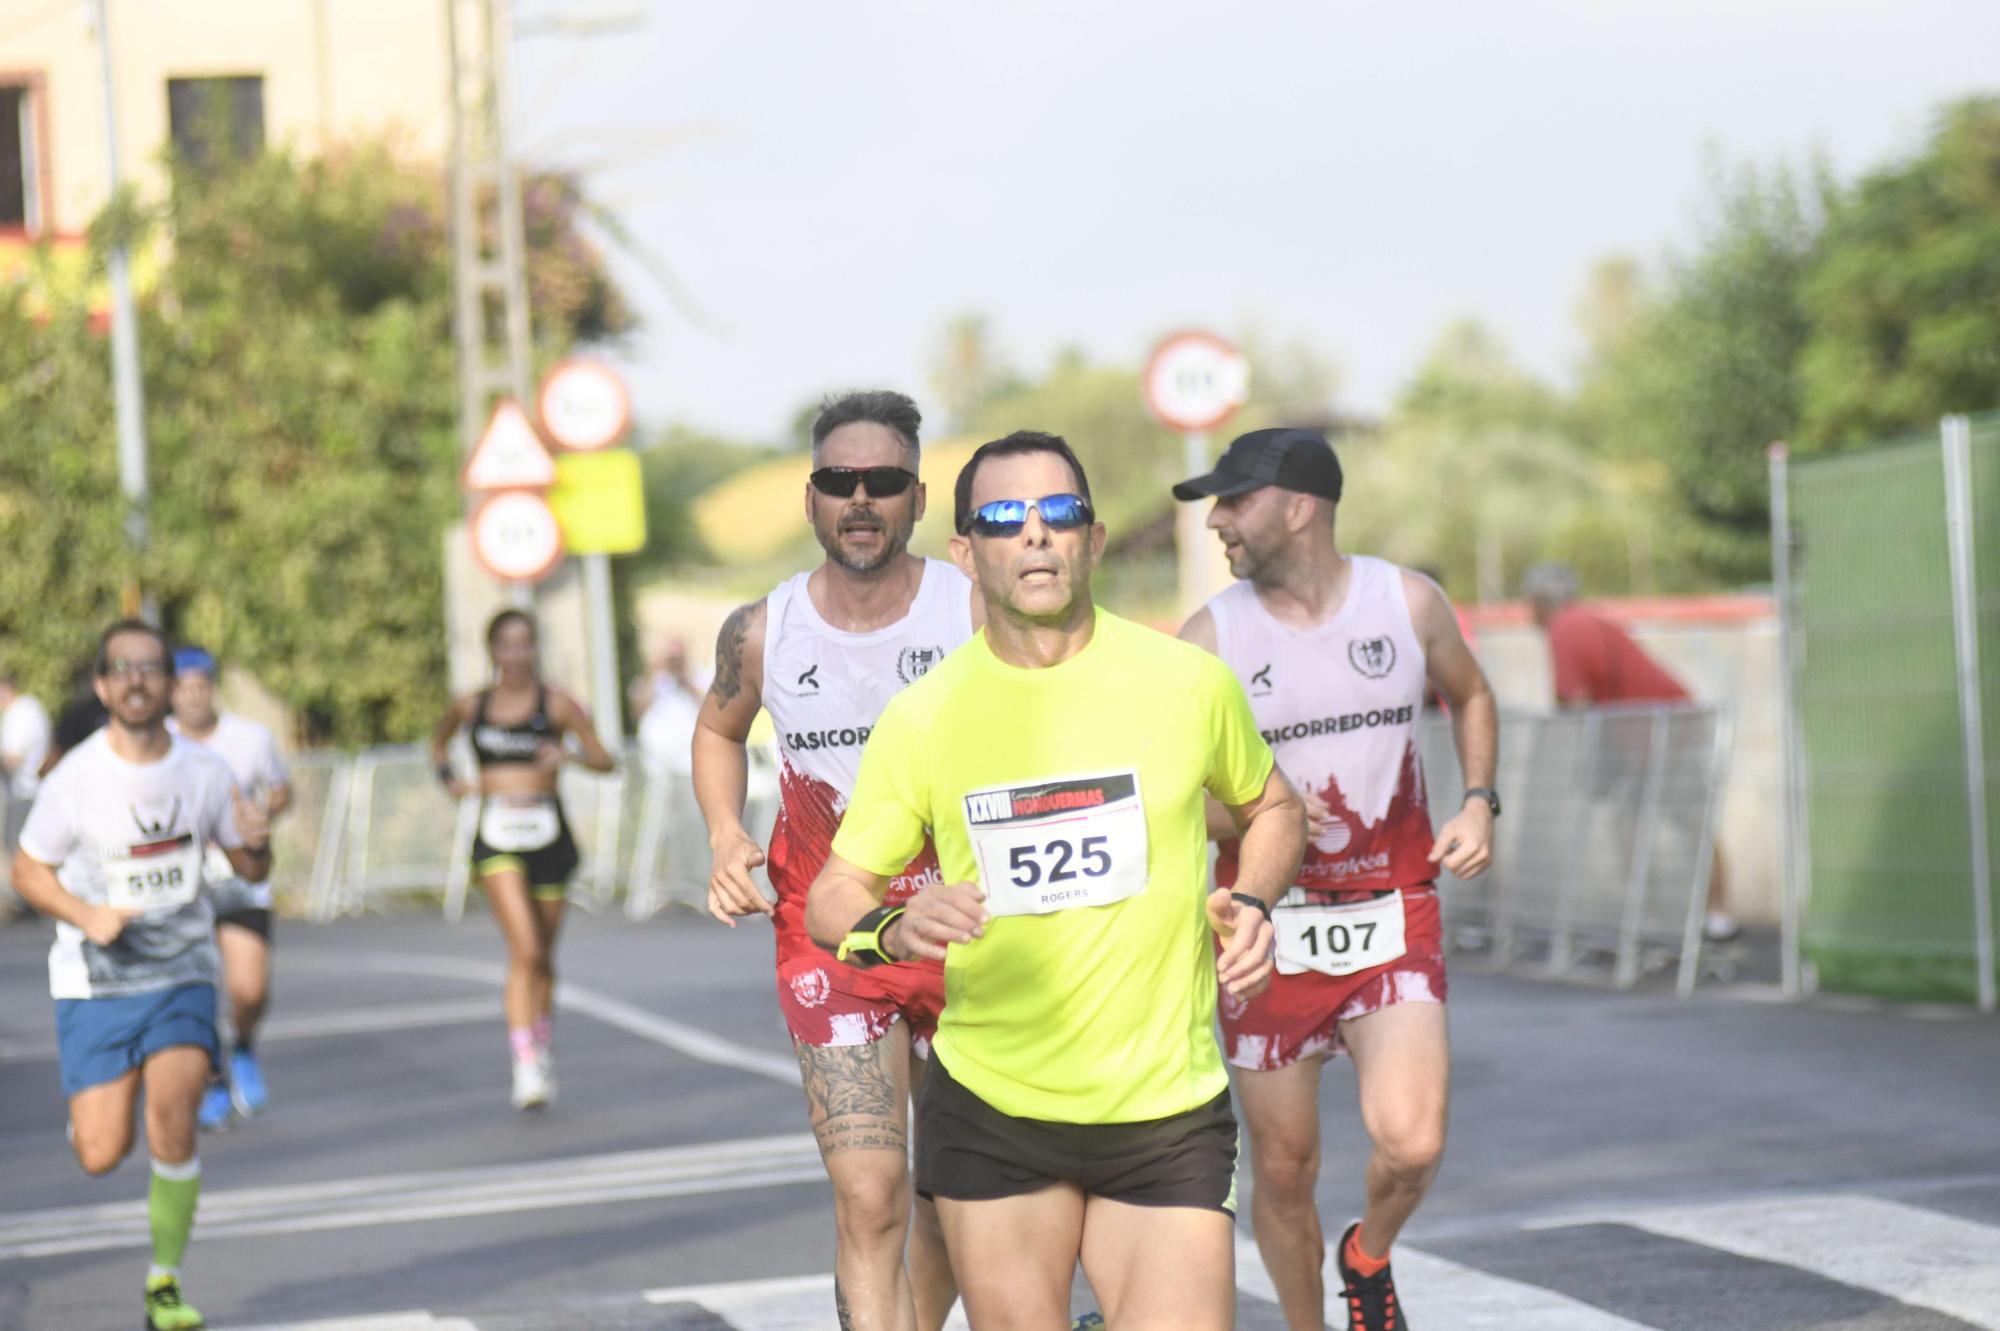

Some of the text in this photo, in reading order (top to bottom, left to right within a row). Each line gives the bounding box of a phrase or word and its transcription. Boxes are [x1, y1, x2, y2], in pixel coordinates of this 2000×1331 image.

[786, 725, 874, 751] CASICOR
[1009, 835, 1112, 888] 525
[1041, 889, 1089, 904] ROGERS
[1300, 922, 1377, 956] 107
